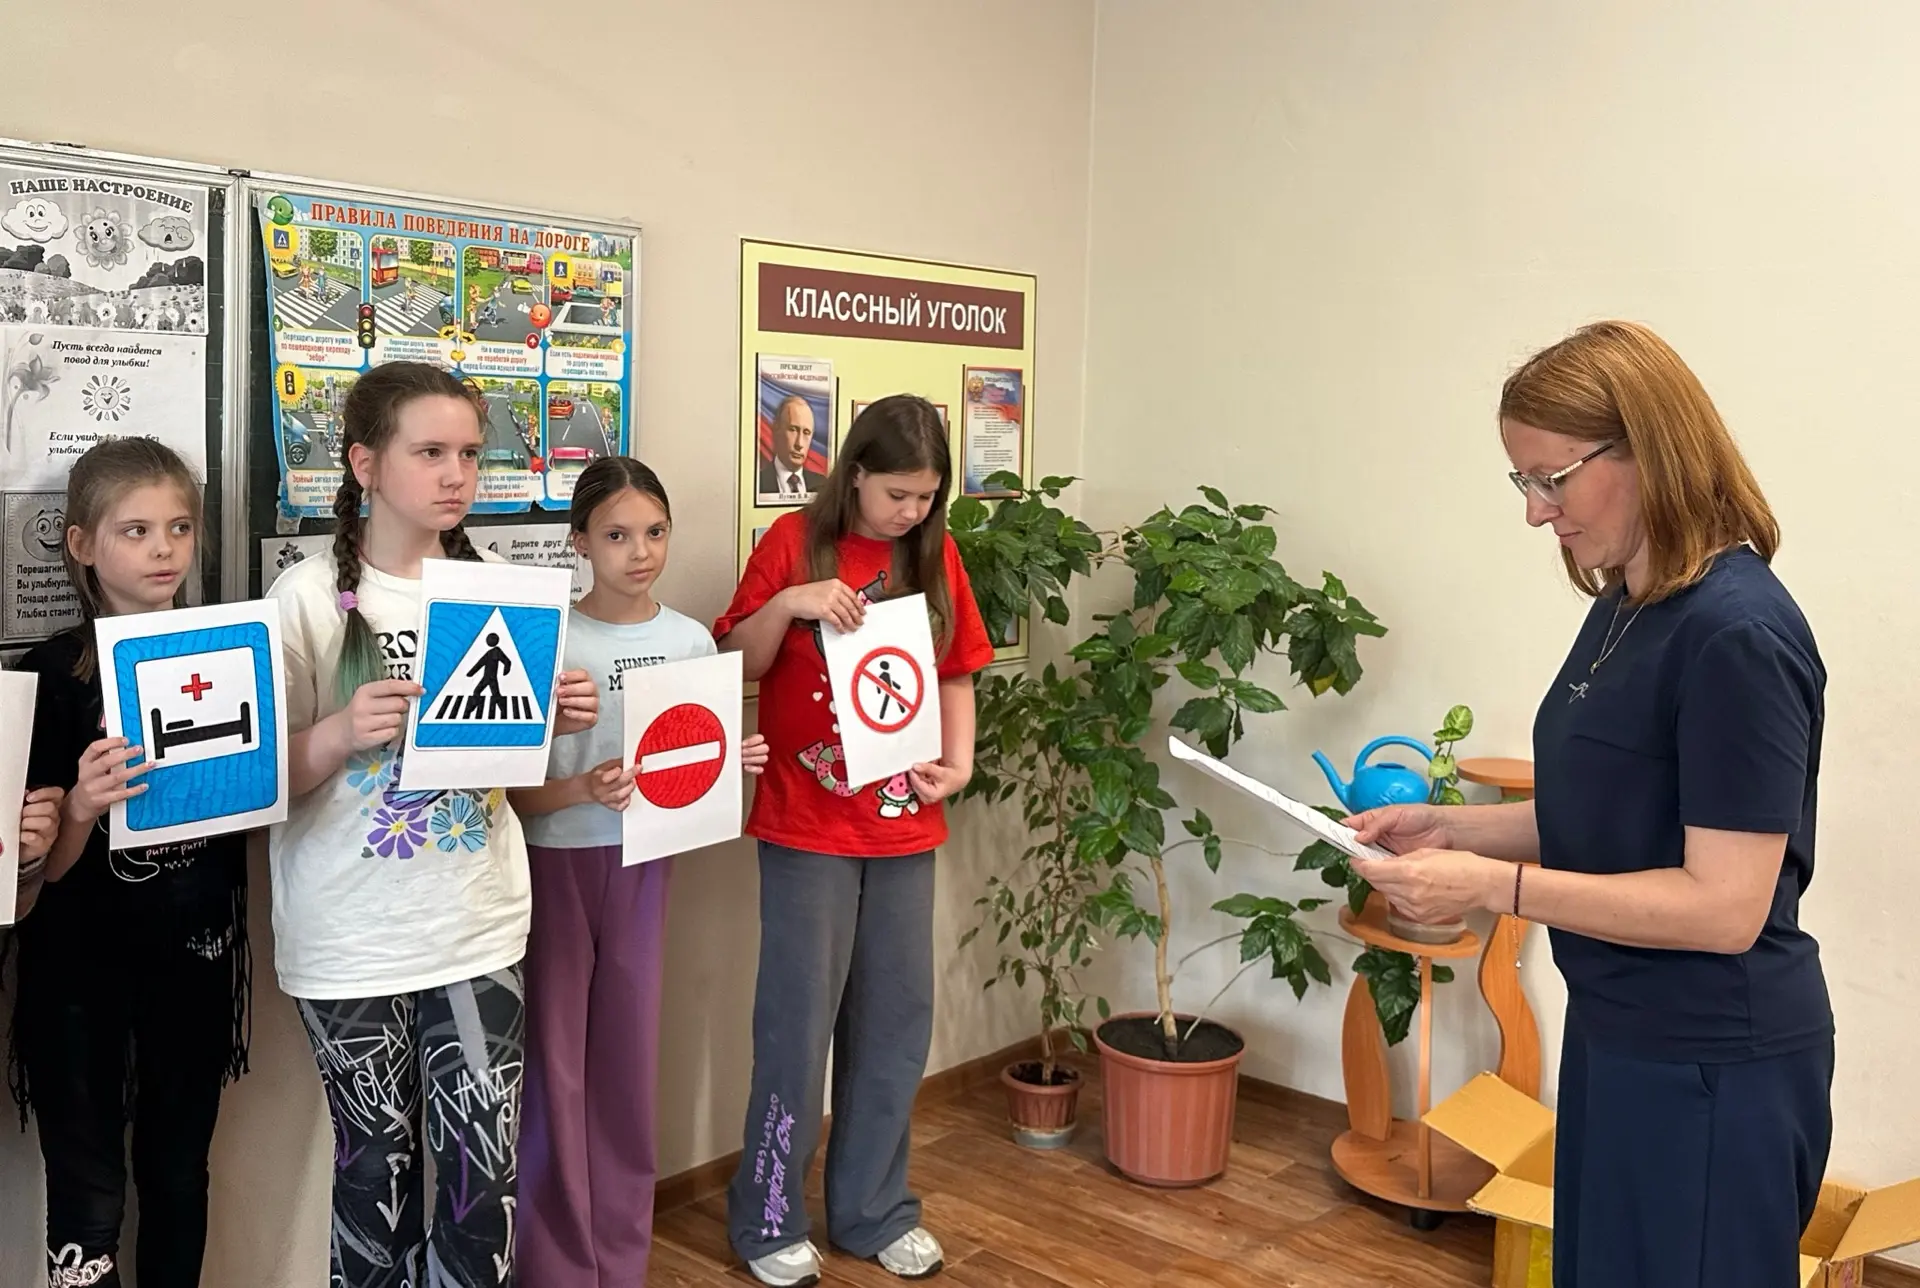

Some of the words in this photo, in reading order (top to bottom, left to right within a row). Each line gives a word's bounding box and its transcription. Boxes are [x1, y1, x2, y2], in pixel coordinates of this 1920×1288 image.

[10, 179, 69, 194] НАШЕ
[72, 179, 193, 214] НАСТРОЕНИЕ
[311, 203, 397, 229] ПРАВИЛА
[403, 214, 503, 242] ПОВЕДЕНИЯ
[509, 228, 529, 245] НА
[535, 231, 591, 253] ДОРОГЕ
[785, 286, 921, 327] КЛАССНЫЙ
[927, 300, 1007, 334] УГОЛОК
[52, 340, 84, 352] Пусть
[86, 343, 115, 353] всегда
[117, 344, 162, 355] найдется
[63, 355, 90, 364] повод
[92, 355, 110, 365] для
[110, 358, 150, 368] улыбки!
[49, 431, 73, 441] Если
[511, 540, 539, 549] Дарите
[542, 540, 562, 548] друг
[510, 552, 535, 560] тепло
[548, 550, 576, 560] улыбки
[17, 564, 69, 576] Перешагнит
[17, 579, 30, 590] Вы
[31, 578, 75, 591] улыбнули
[17, 594, 49, 604] Почаще
[17, 608, 48, 619] Улыбка
[49, 608, 75, 617] станет
[614, 656, 667, 673] SUNSET
